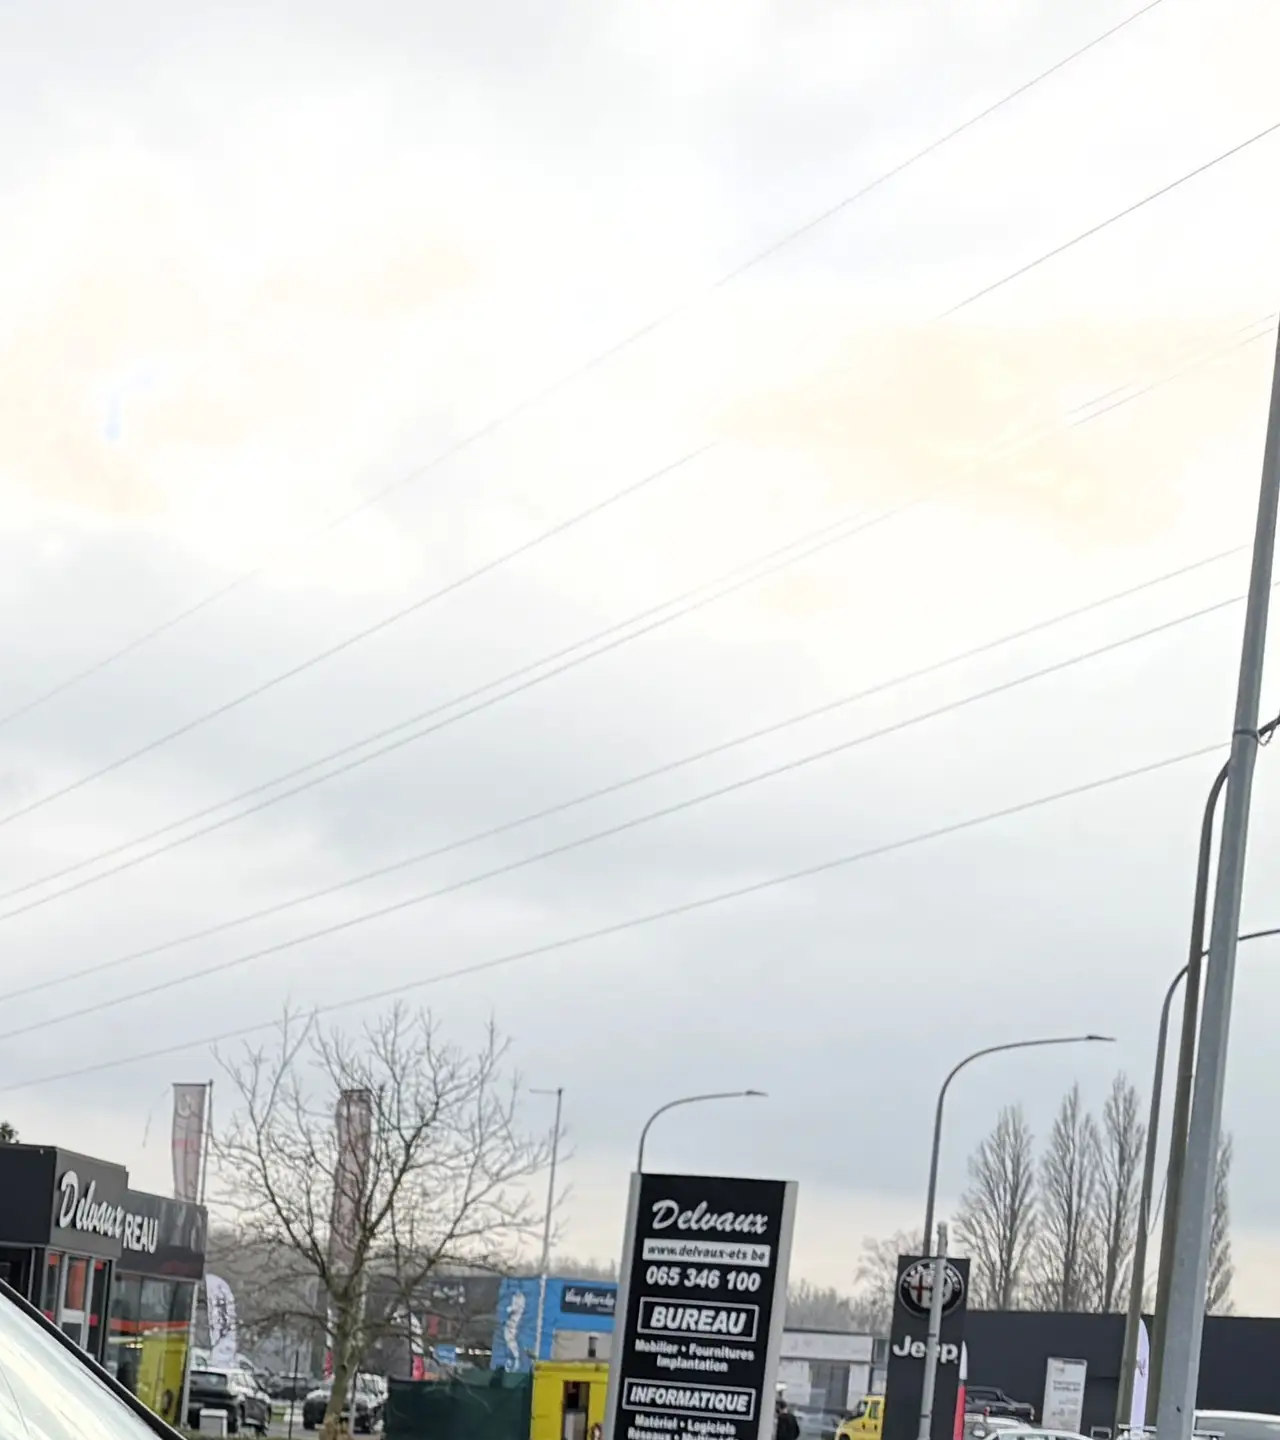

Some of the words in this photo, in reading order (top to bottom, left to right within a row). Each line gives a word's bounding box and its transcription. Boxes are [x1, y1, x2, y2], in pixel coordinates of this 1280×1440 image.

[652, 1199, 769, 1235] Delvaux
[645, 1265, 681, 1286] 065
[683, 1267, 721, 1289] 346
[726, 1270, 761, 1292] 100
[649, 1305, 747, 1335] BUREAU
[656, 1354, 729, 1373] Implantation
[688, 1342, 756, 1361] Fournitures
[629, 1385, 749, 1412] INFORMATIQUE
